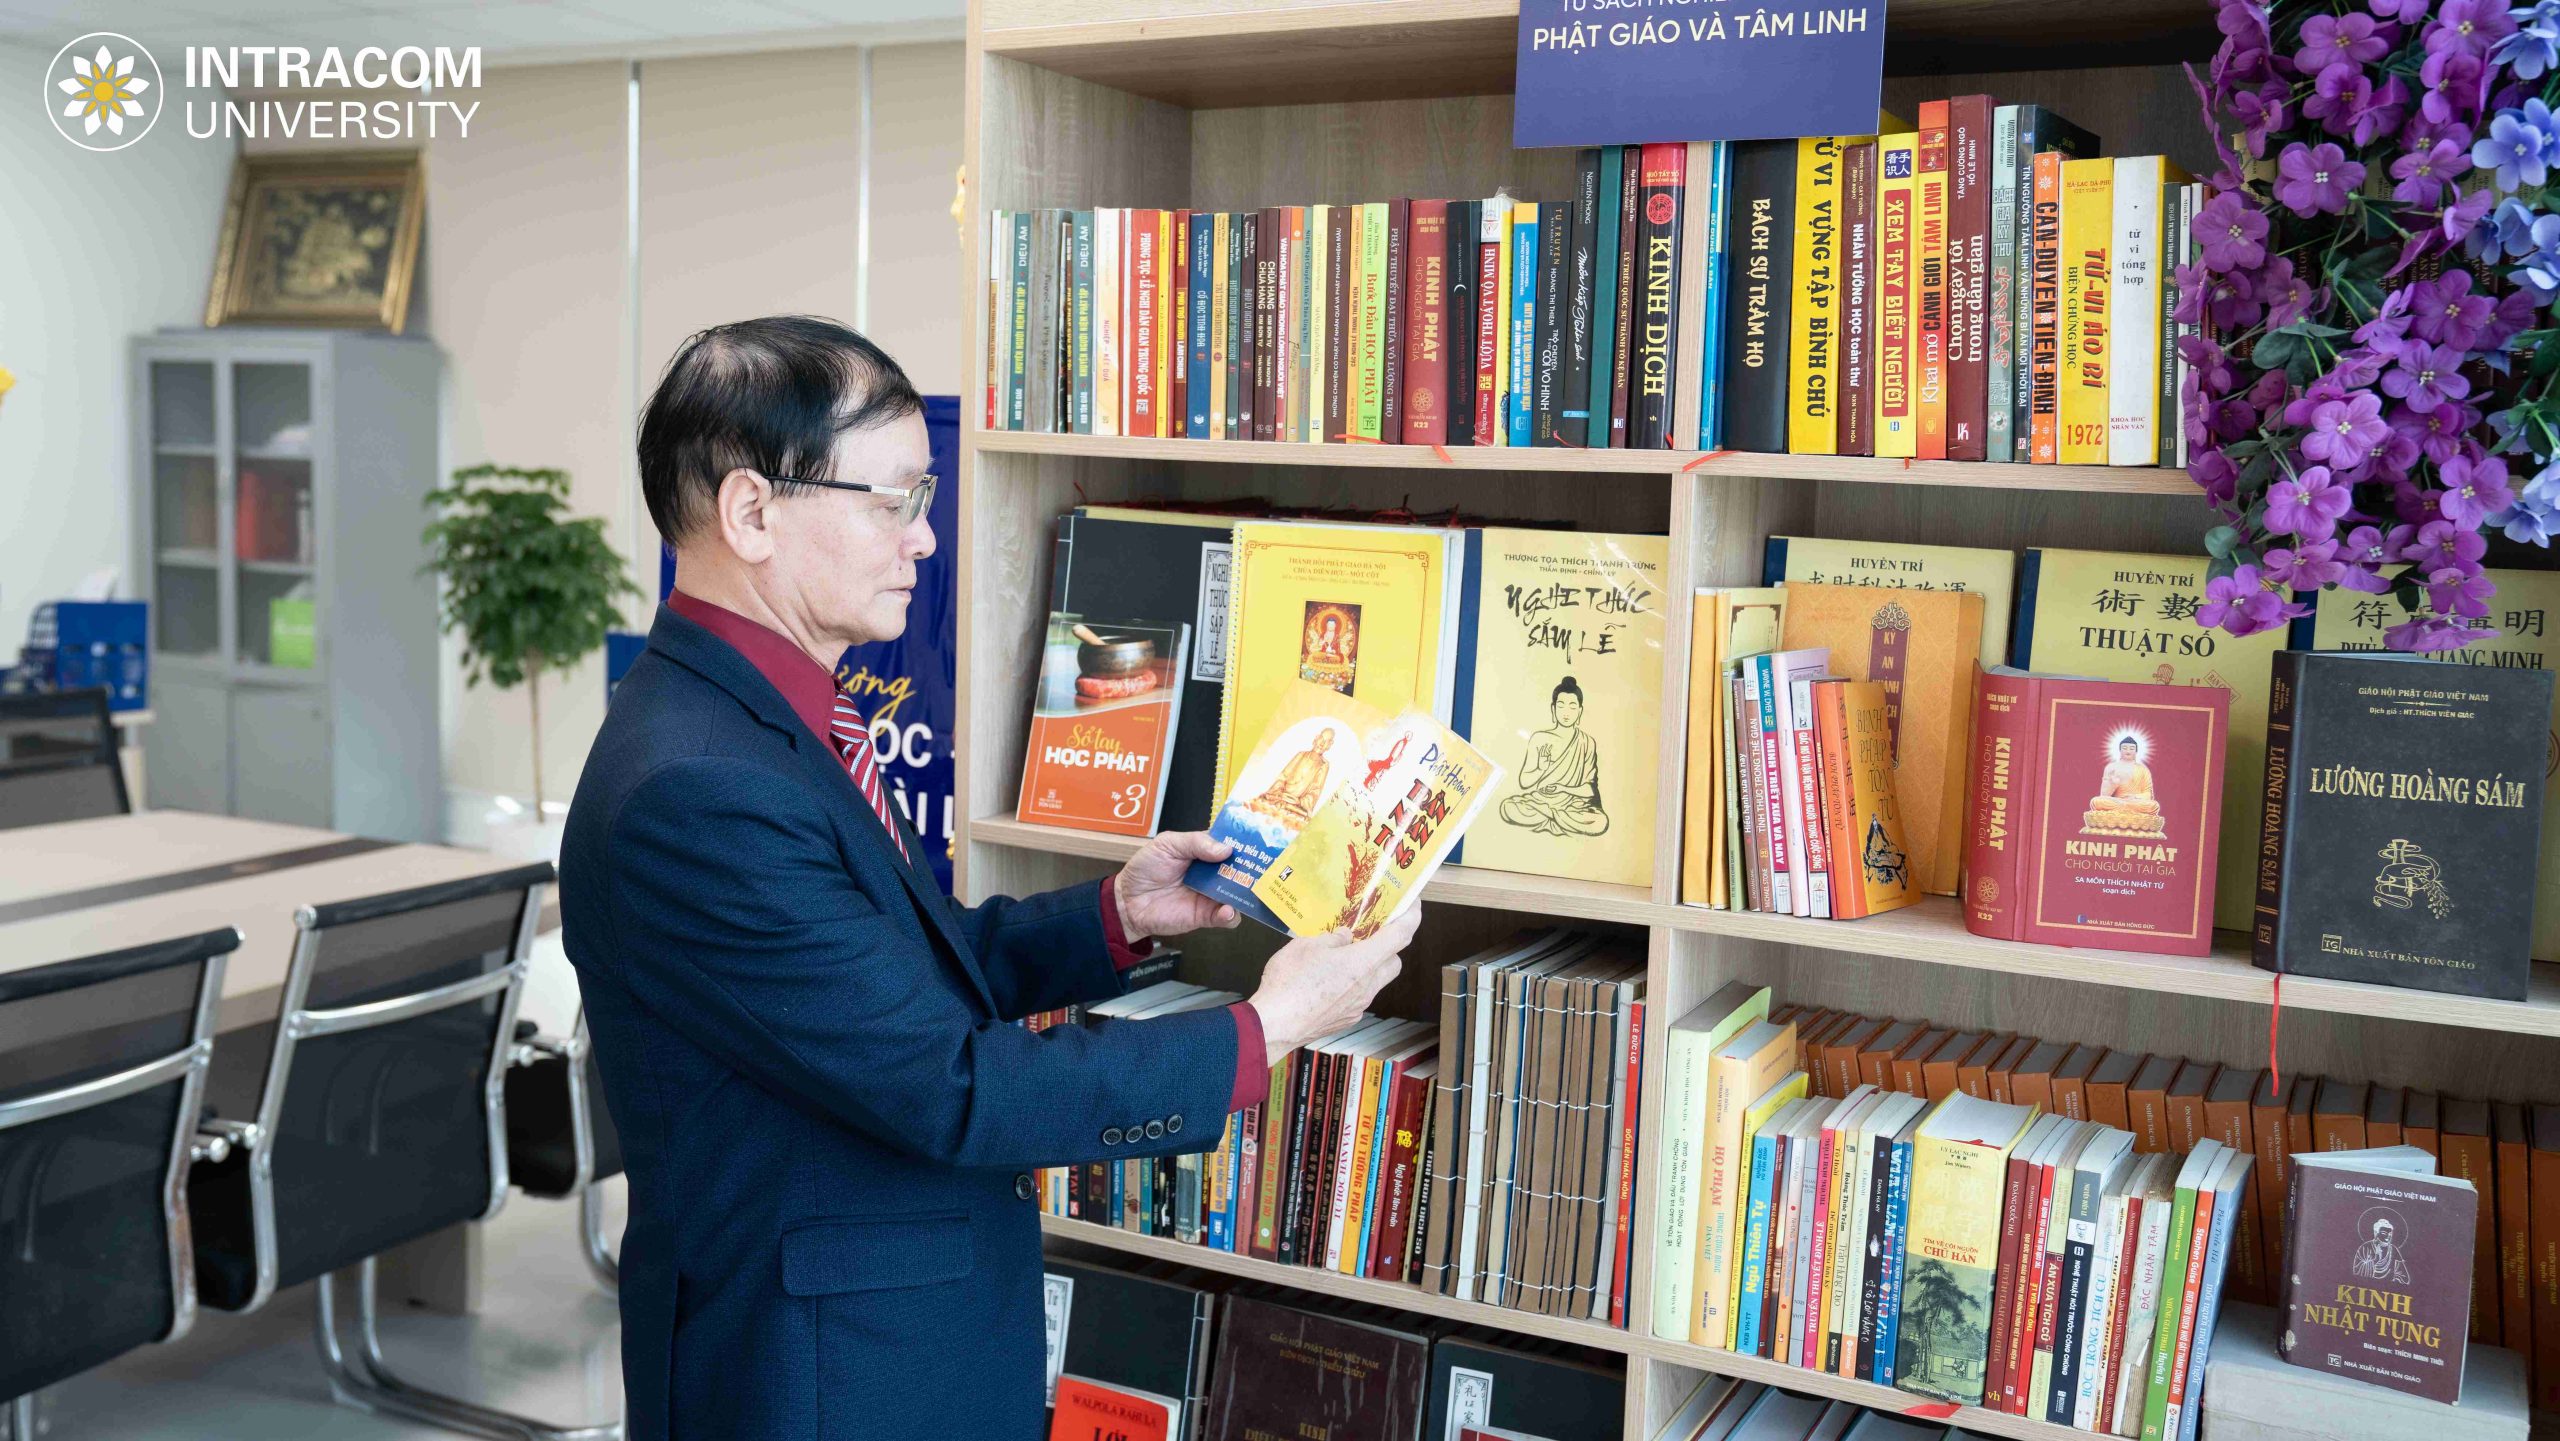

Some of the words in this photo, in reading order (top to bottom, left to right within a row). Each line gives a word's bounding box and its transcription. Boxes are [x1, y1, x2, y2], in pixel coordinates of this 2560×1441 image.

[1533, 22, 1602, 55] PHẬT
[1609, 19, 1681, 46] GIÁO
[1689, 12, 1727, 41] VÀ
[1735, 8, 1794, 39] TÂM
[1804, 8, 1867, 35] LINH
[1814, 162, 1832, 186] VI
[1924, 182, 1942, 214] LINH
[1752, 198, 1773, 250] BÁCH
[1807, 200, 1832, 261] VỰNG
[1886, 200, 1904, 244] XEM
[1924, 217, 1942, 254] TÂM
[2129, 229, 2142, 239] tử
[1140, 233, 1151, 258] PHONG
[1388, 228, 1400, 254] PHẬT
[1852, 224, 1866, 257] NHÂN
[1949, 238, 1964, 264] tốt
[1966, 234, 1984, 272] gian
[2129, 244, 2139, 254] vi
[1485, 248, 1496, 278] MINH
[1647, 236, 1672, 314] KINH
[1746, 256, 1769, 280] SỰ
[1886, 248, 1904, 288] TAY
[1922, 257, 1941, 288] GIỚI
[2122, 258, 2146, 270] tổng
[1366, 273, 1378, 301] Bước
[1426, 256, 1440, 306] KINH
[1483, 280, 1494, 296] VÔ
[1807, 266, 1835, 308] TẬP
[1851, 260, 1866, 304] TƯỚNG
[1949, 266, 1967, 310] ngày
[1967, 276, 1982, 310] dân
[2068, 266, 2080, 294] BIỆN
[2083, 248, 2112, 314] TỬ-VI
[2124, 274, 2144, 286] hợp
[1138, 290, 1150, 306] NGHI
[1386, 297, 1396, 314] ĐẠI
[1922, 291, 1941, 331] CẢNH
[1482, 298, 1494, 336] THOÁT
[1848, 308, 1862, 334] HỌC
[1884, 296, 1904, 338] BIẾT
[2067, 299, 2080, 344] CHỨNG
[1138, 324, 1150, 342] GIAN
[1364, 331, 1376, 365] HỌC
[1421, 313, 1440, 362] PHẬT
[1808, 317, 1834, 368] BÌNH
[1923, 333, 1940, 360] mở
[1948, 313, 1963, 361] Chọn
[1968, 312, 1983, 362] trong
[2082, 320, 2108, 356] ÁO
[1138, 343, 1150, 369] TRUNG
[1480, 338, 1492, 369] VƯỢT
[1640, 323, 1668, 396] DỊCH
[1743, 341, 1764, 368] HỌ
[1850, 336, 1862, 364] toàn
[2064, 346, 2077, 370] HỌC
[1364, 367, 1379, 404] PHẬT
[1850, 366, 1860, 387] thư
[1884, 346, 1904, 410] NGƯỜI
[1922, 364, 1938, 404] Khai
[2082, 362, 2106, 389] BÍ
[1382, 397, 1393, 416] THỌ
[1807, 374, 1831, 418] CHÚ
[2067, 424, 2104, 446] 1972
[2114, 571, 2165, 584] HUYỀN
[2168, 574, 2194, 587] TRÍ
[1505, 582, 1581, 626] NGHI
[1527, 617, 1572, 664] SẮM
[1578, 623, 1626, 654] LỄ
[2080, 626, 2174, 658] THUẬT
[2179, 630, 2216, 658] SỐ
[2358, 686, 2378, 696] GIÁO
[2380, 687, 2396, 698] HỘI
[2398, 688, 2422, 699] PHẬT
[2424, 689, 2444, 699] GIÁO
[2446, 691, 2466, 702] VIỆT
[2468, 692, 2490, 702] NAM
[1066, 723, 1096, 749] Sổ
[1094, 728, 1122, 756] tay
[1766, 738, 1778, 768] MINH
[1044, 746, 1090, 768] HỌC
[1093, 752, 1150, 774] PHẬT
[1992, 736, 2011, 790] KINH
[1768, 770, 1782, 800] TRIẾT
[2310, 764, 2385, 798] LƯƠNG
[2390, 768, 2470, 804] HOÀNG
[2475, 773, 2526, 808] SÁM
[1113, 784, 1146, 818] 3
[1772, 801, 1782, 822] XƯA
[1773, 825, 1783, 840] VÀ
[1986, 796, 2008, 851] PHẬT
[1774, 842, 1785, 864] NAY
[2066, 840, 2118, 858] KINH
[2124, 844, 2178, 864] PHẬT
[2064, 859, 2091, 870] CHO
[2094, 861, 2132, 873] NGƯỜI
[2136, 864, 2153, 876] TẠI
[2156, 866, 2176, 876] GIA
[1362, 1114, 1372, 1130] TỬ
[1360, 1131, 1368, 1145] VI
[1354, 1148, 1368, 1188] TƯỚNG
[1350, 1191, 1361, 1223] PHÁP
[1752, 1198, 1766, 1217] Tự
[2334, 1182, 2352, 1191] GIÁO
[2354, 1184, 2365, 1194] HỘI
[2366, 1186, 2384, 1196] PHẬT
[2384, 1188, 2402, 1197] GIÁO
[2404, 1190, 2418, 1200] VIỆT
[2420, 1194, 2436, 1203] NAM
[1748, 1222, 1762, 1262] Thiên
[1923, 1244, 1948, 1262] CHỮ
[1951, 1250, 1976, 1265] HÁN
[2191, 1227, 2206, 1261] Stephen
[1746, 1264, 1757, 1294] Ngũ
[2188, 1262, 2200, 1284] Guise
[2045, 1279, 2056, 1300] XƯA
[2068, 1298, 2078, 1310] NÓI
[2334, 1284, 2413, 1316] KINH
[2042, 1302, 2054, 1325] TÍCH
[2066, 1311, 2076, 1332] TRƯỚC
[2304, 1303, 2370, 1336] NHẬT
[2376, 1314, 2440, 1349] TỤNG
[2040, 1326, 2051, 1341] CŨ
[2064, 1333, 2074, 1352] CÔNG
